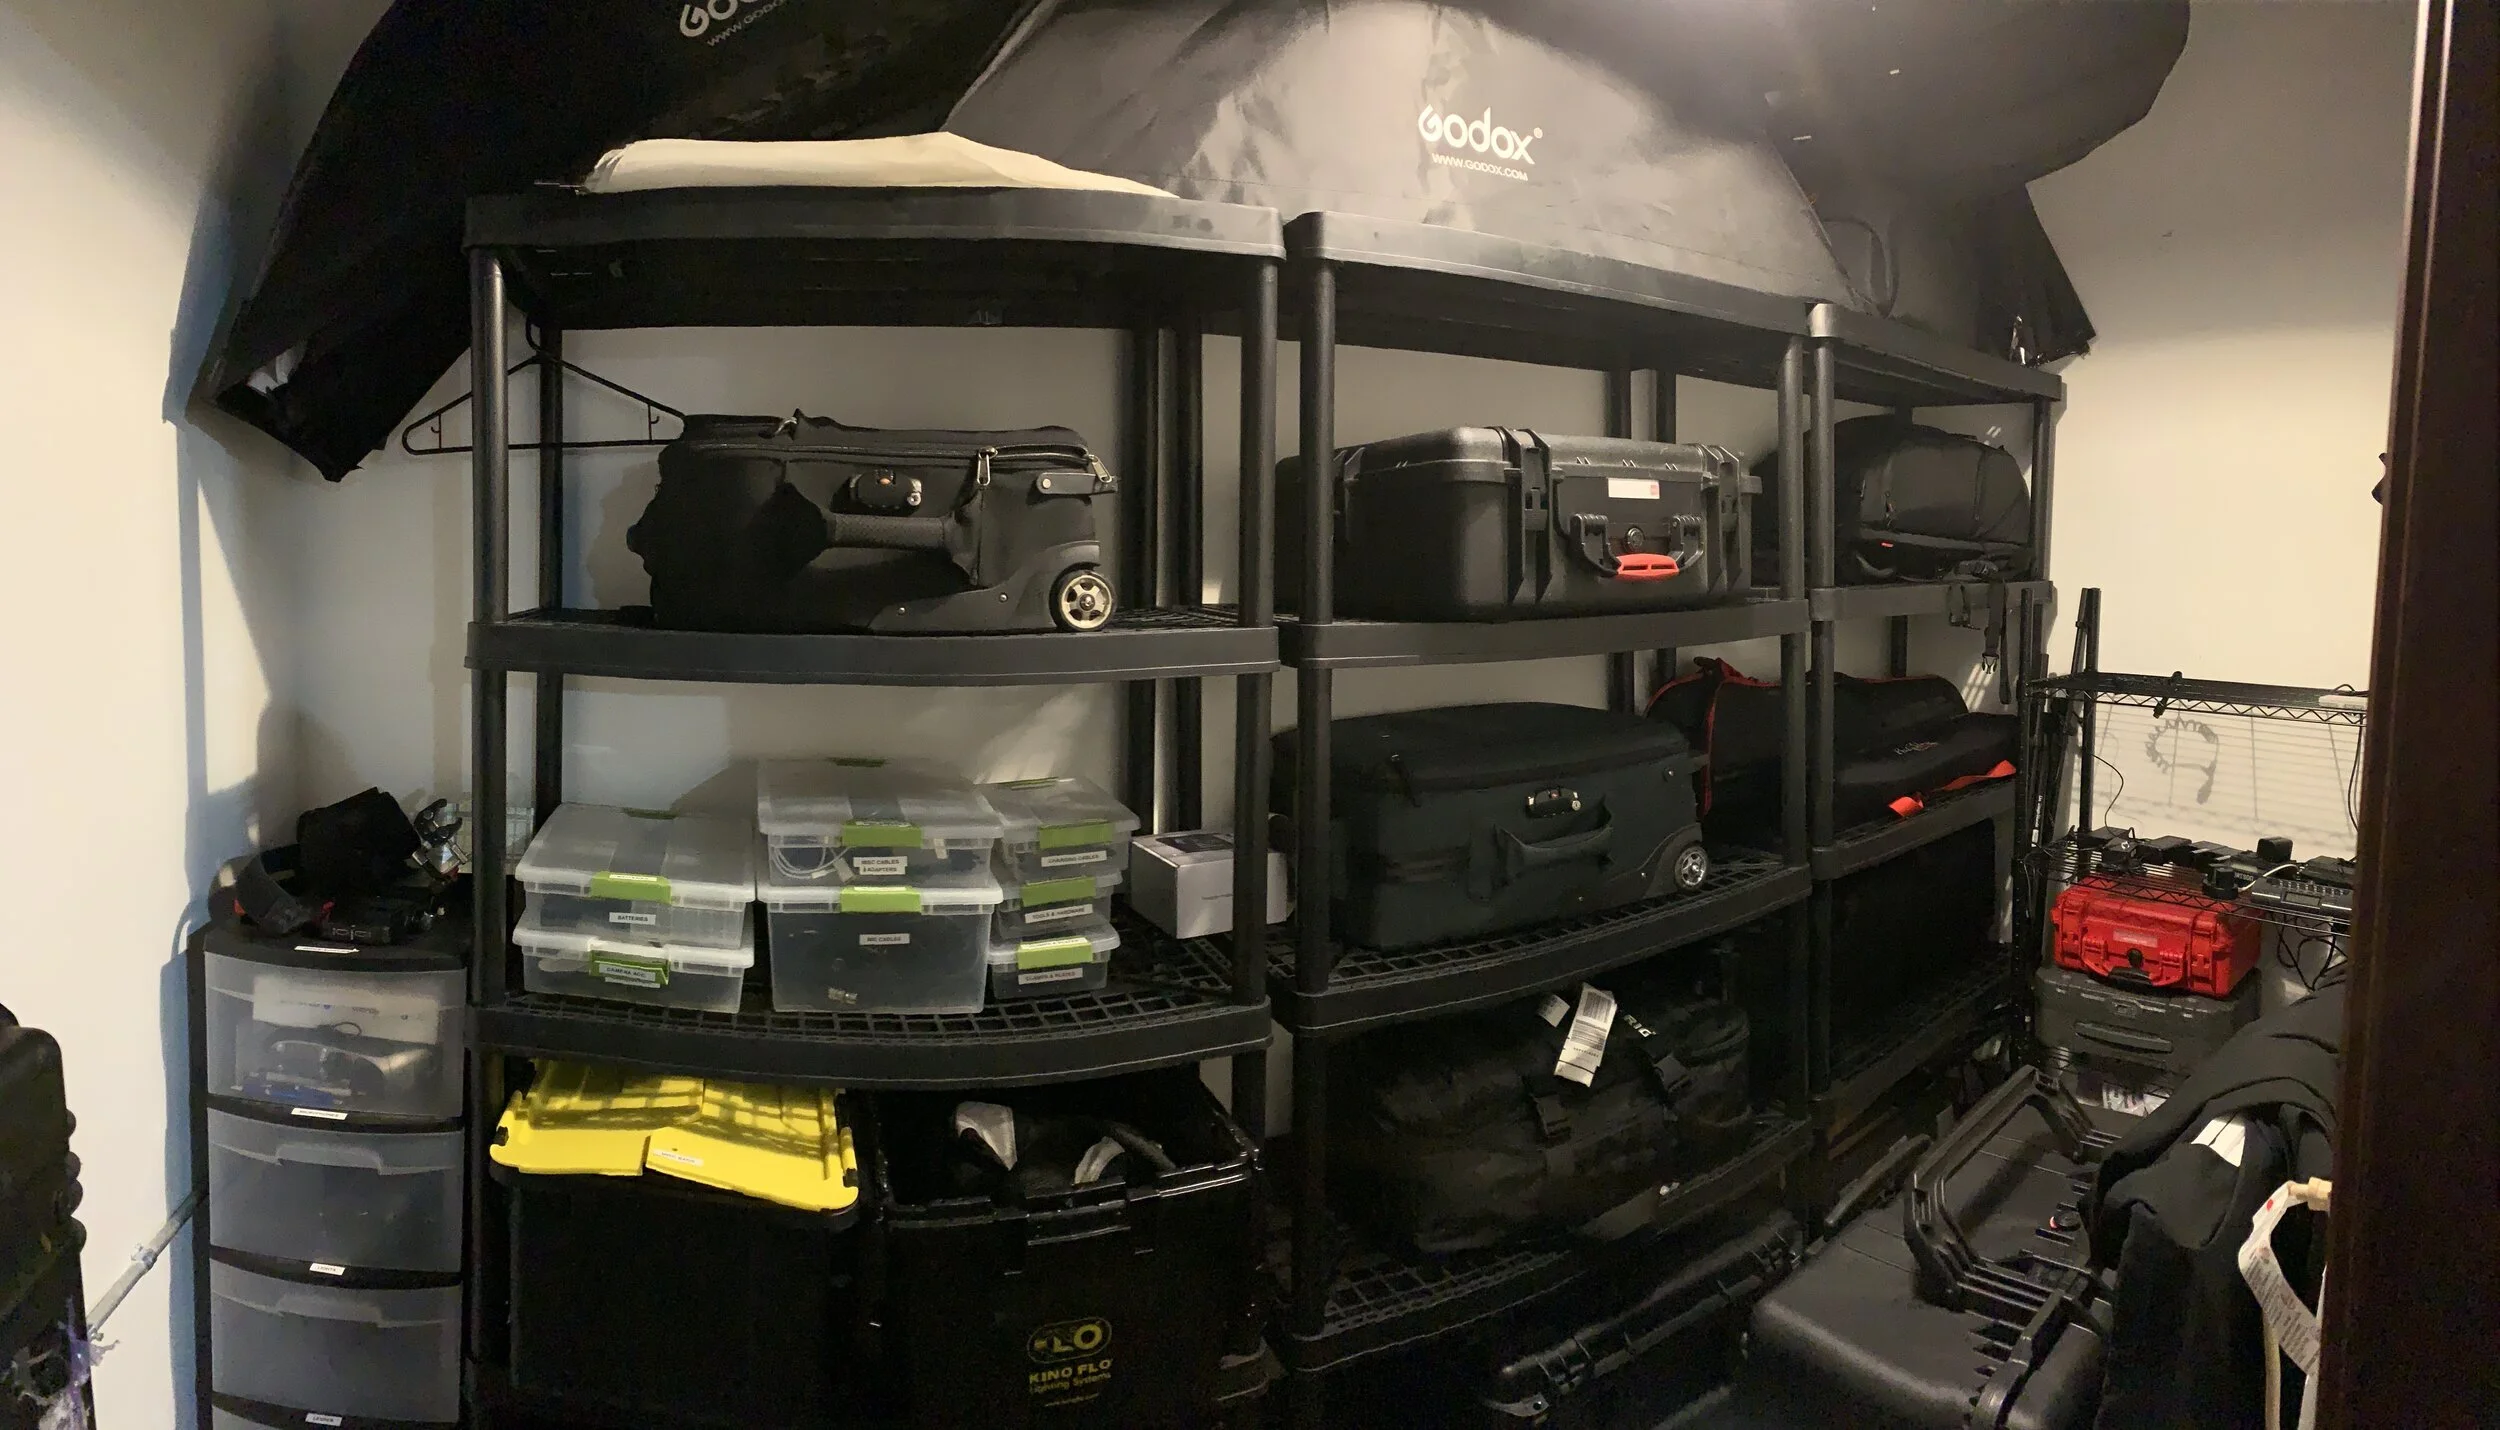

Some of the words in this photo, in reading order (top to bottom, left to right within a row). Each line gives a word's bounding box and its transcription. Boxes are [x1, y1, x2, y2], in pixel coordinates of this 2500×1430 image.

[680, 0, 758, 37] Go
[1418, 104, 1536, 165] Godox
[1431, 152, 1529, 182] WWW.GODOX.COM
[1056, 907, 1085, 916] HARDWARE
[606, 967, 632, 975] CAMERA
[1029, 1367, 1073, 1385] KINO
[1077, 1359, 1112, 1376] FLO
